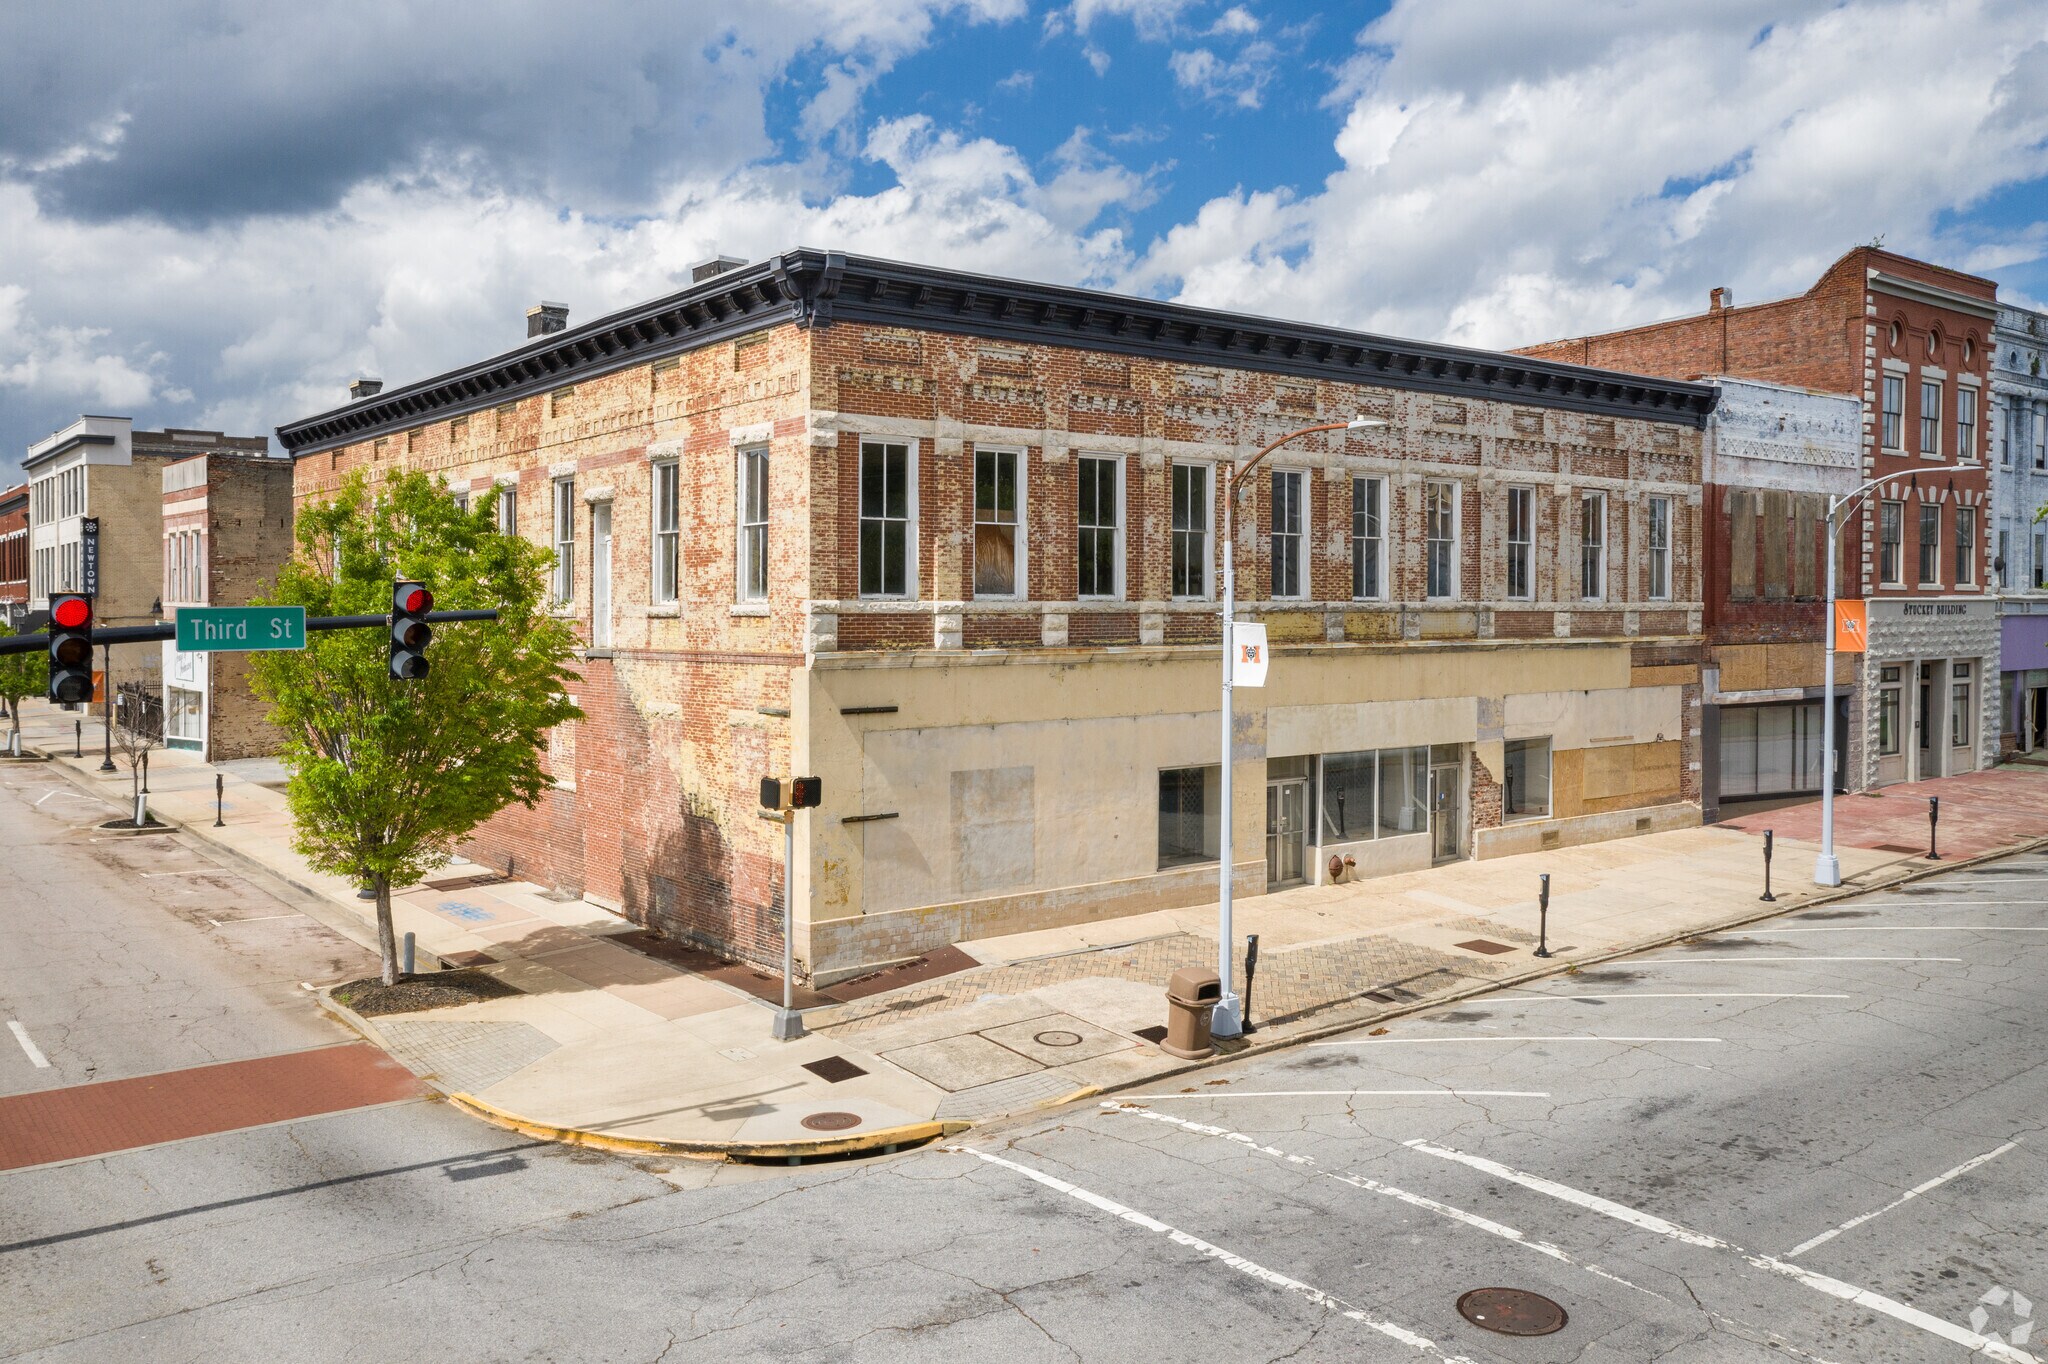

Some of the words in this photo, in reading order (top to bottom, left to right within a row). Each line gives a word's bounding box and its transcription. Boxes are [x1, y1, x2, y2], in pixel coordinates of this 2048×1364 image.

[87, 538, 95, 594] NEWTOWN
[1903, 602, 1934, 616] STUCKEY
[1936, 604, 1967, 615] BUILDING
[191, 619, 247, 640] Third
[270, 618, 292, 639] St
